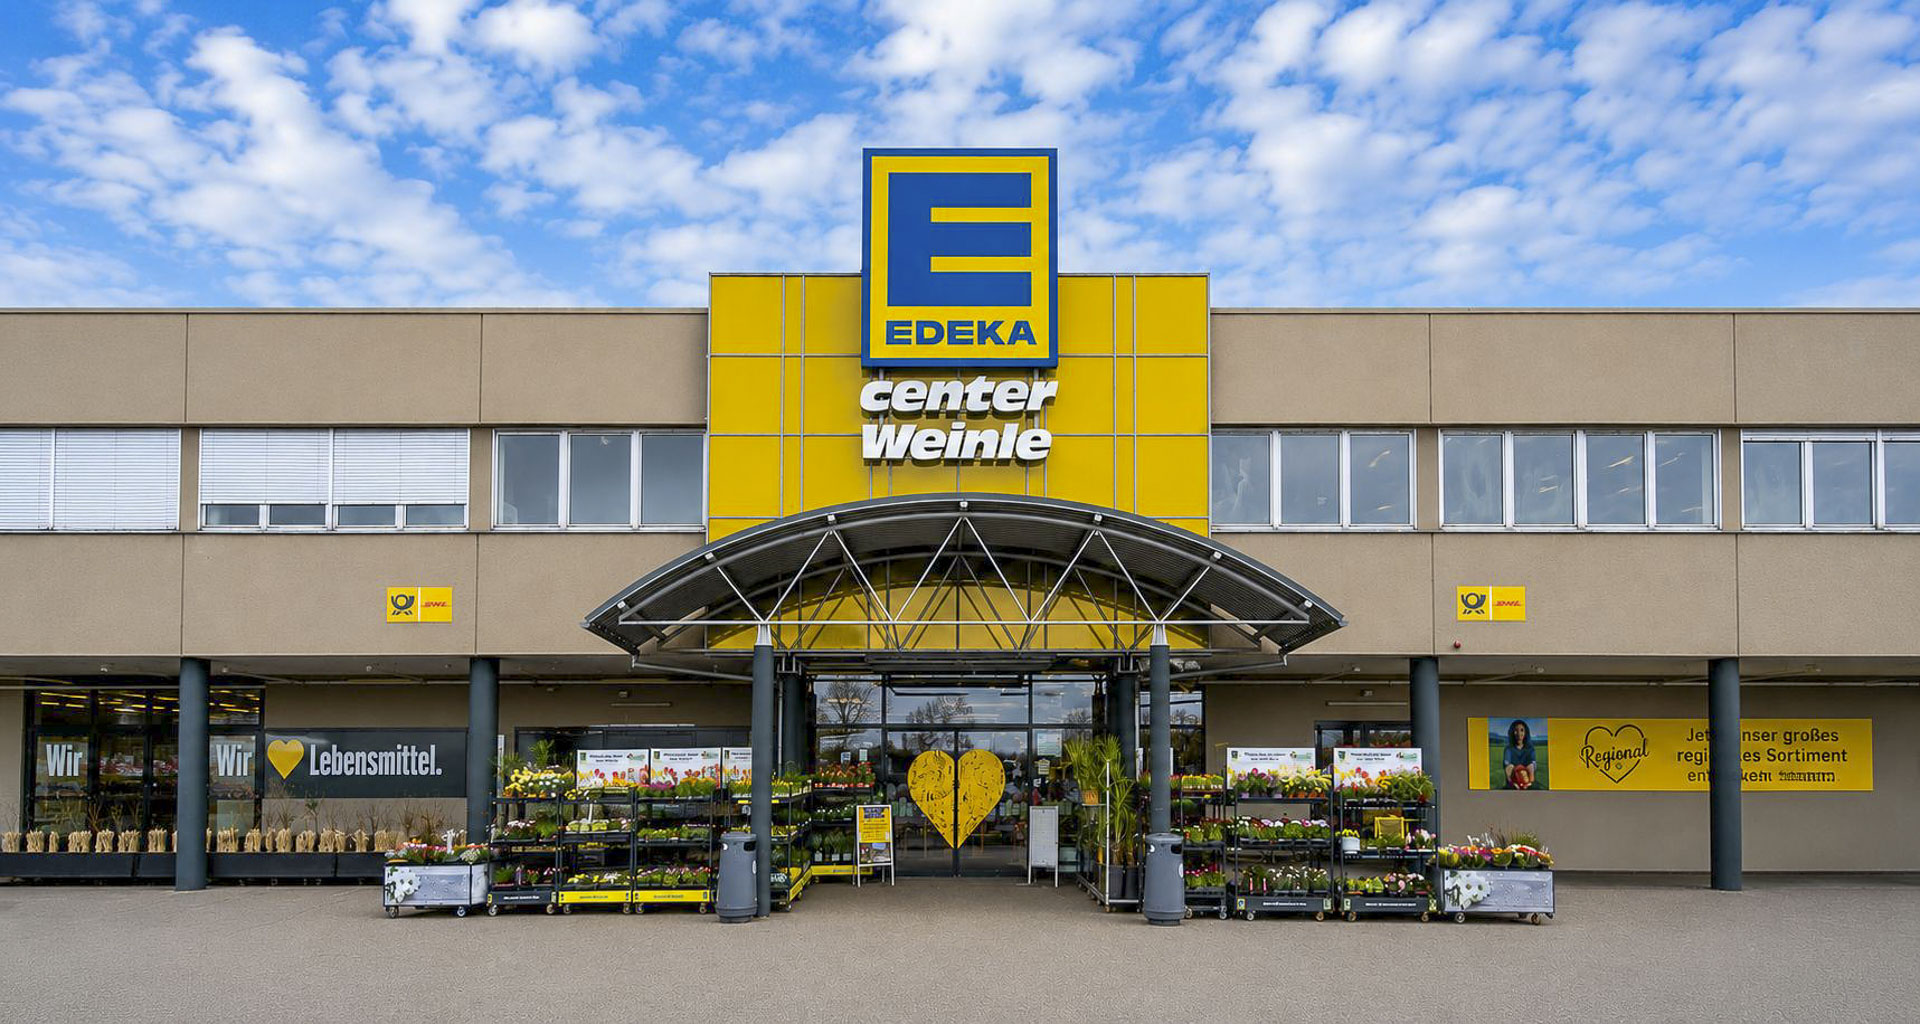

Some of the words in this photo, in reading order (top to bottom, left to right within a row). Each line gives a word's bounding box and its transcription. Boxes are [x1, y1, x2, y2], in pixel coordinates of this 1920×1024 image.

[885, 320, 1037, 345] EDEKA
[860, 375, 1059, 413] center
[862, 421, 1053, 461] Weinle
[1686, 728, 1711, 742] Jet
[1742, 731, 1778, 742] nser
[1783, 728, 1839, 745] großes
[46, 744, 83, 777] Wir
[216, 744, 253, 777] Wir
[310, 744, 443, 776] Lebensmittel.
[1579, 738, 1650, 771] Regional
[1677, 748, 1761, 765] regies
[1766, 748, 1847, 763] Sortiment
